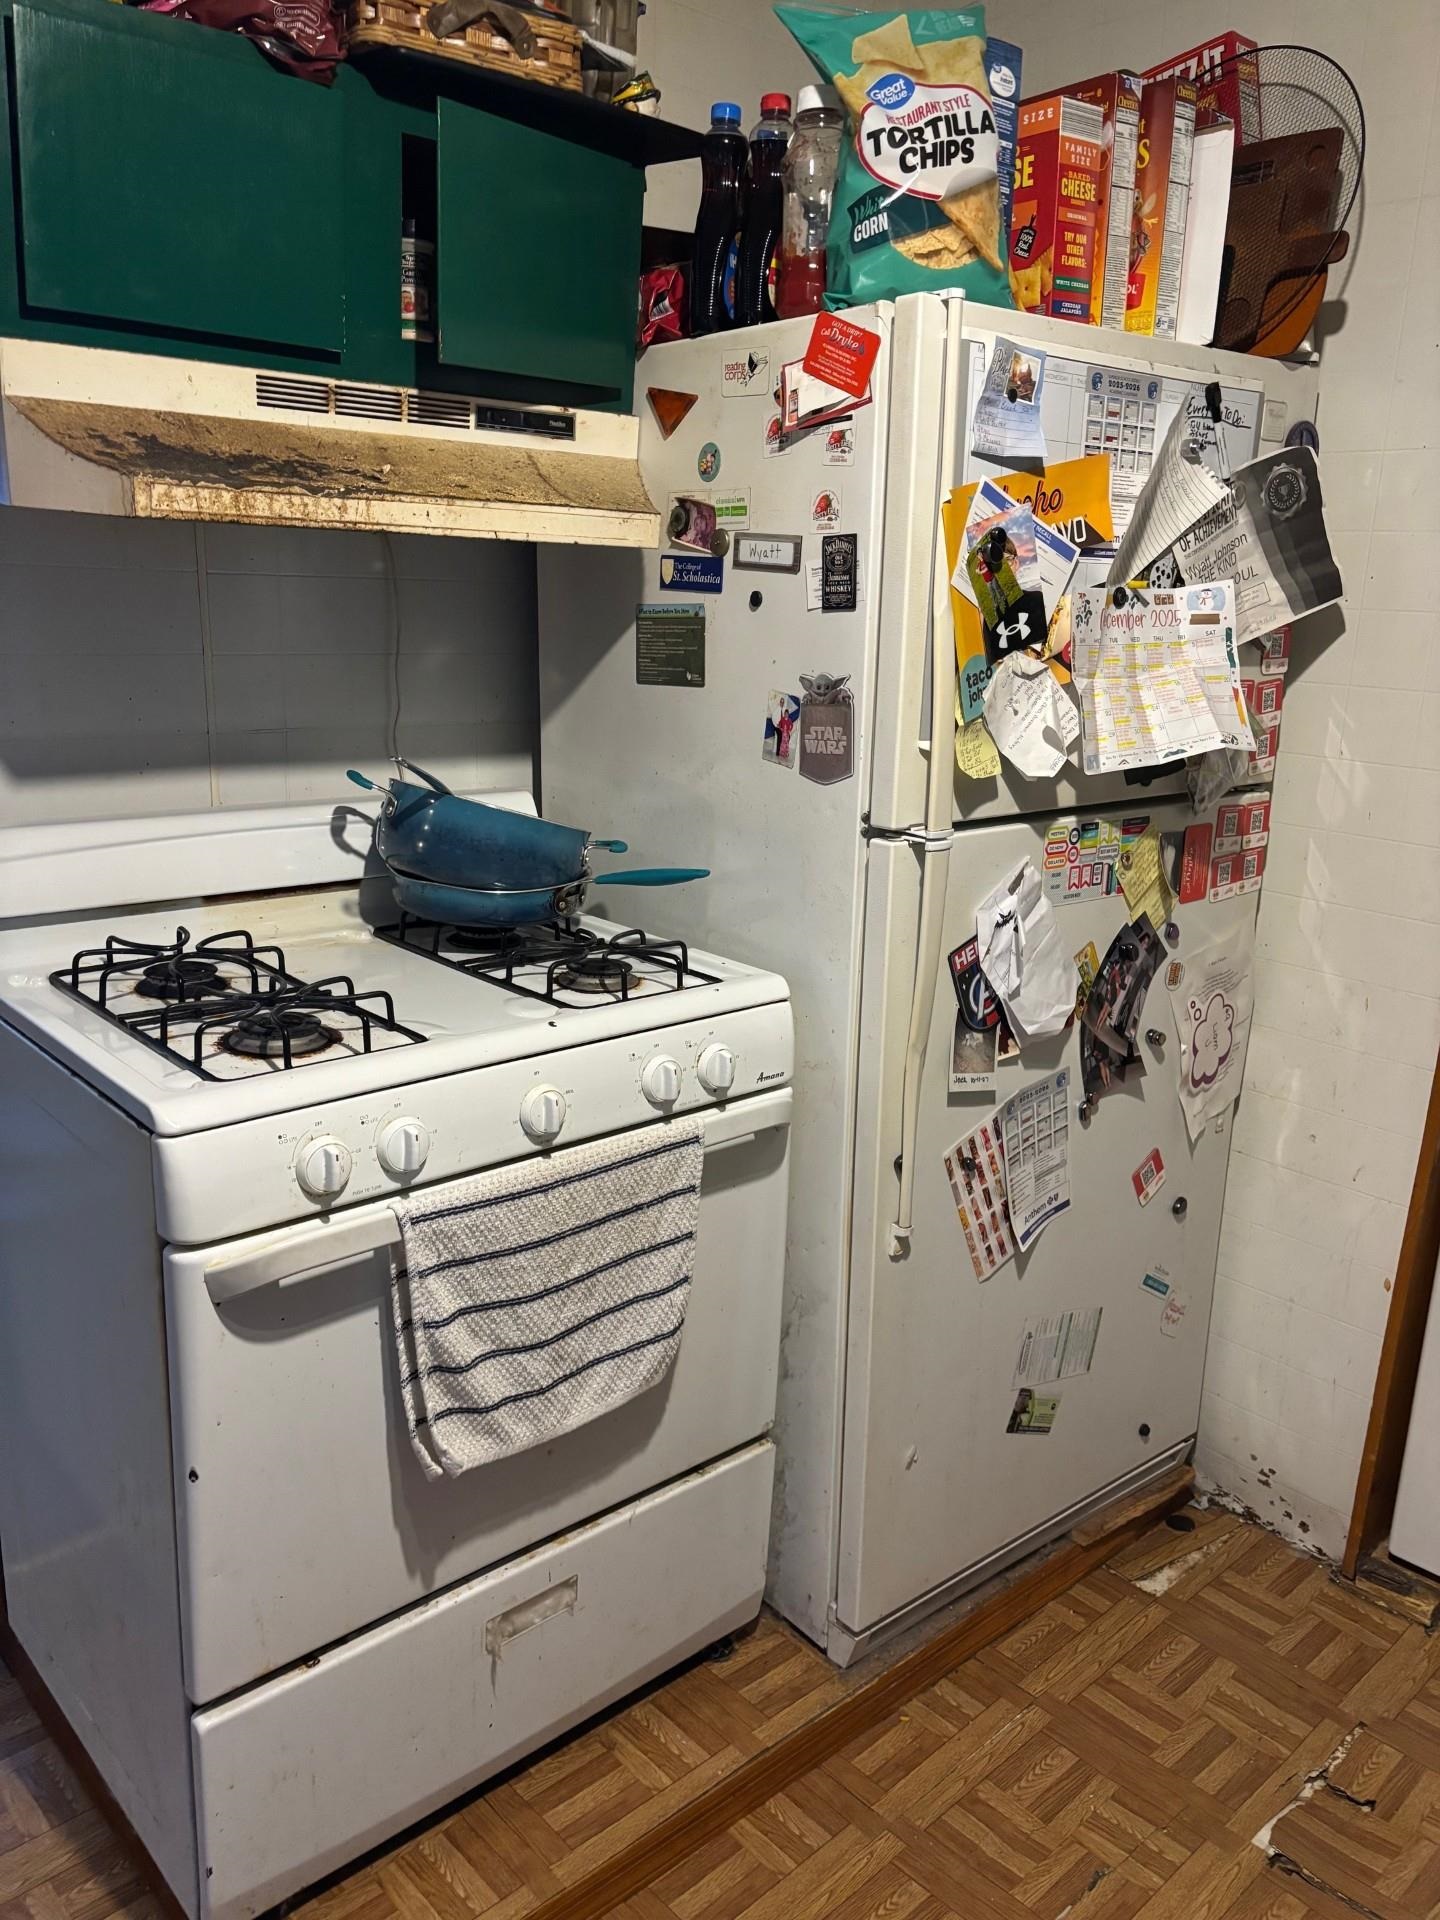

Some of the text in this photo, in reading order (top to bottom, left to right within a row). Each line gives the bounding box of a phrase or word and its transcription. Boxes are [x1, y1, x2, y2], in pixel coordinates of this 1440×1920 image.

[870, 78, 906, 101] Great
[880, 90, 908, 105] Value
[886, 94, 972, 127] RESTAURANT STYLE
[1023, 107, 1054, 125] SIZE
[866, 109, 996, 157] TORTILLA
[899, 137, 975, 174] CHIPS
[1065, 142, 1097, 158] FAMILY
[1071, 154, 1091, 166] SIZE
[1068, 171, 1091, 182] BAKED
[1061, 177, 1097, 202] CHEESE
[853, 211, 889, 243] CORN
[1018, 240, 1030, 251] Real
[1064, 231, 1087, 245] TRY OUR
[1066, 244, 1084, 256] OTHER
[1070, 281, 1090, 289] CHEDDAR
[1062, 301, 1082, 309] CHEDDAR
[831, 320, 842, 330] GOT
[725, 362, 747, 373] reading
[725, 370, 747, 383] corps
[1108, 380, 1141, 391] 2025-2026
[1178, 534, 1192, 553] OF
[1193, 504, 1239, 543] ACHIEVEMENT
[749, 543, 782, 561] Wyatt
[1185, 533, 1249, 581] Wyatt Johnson
[675, 562, 683, 570] The
[682, 562, 697, 572] College
[1200, 552, 1238, 585] THE KIND
[673, 571, 721, 584] St. Scholastica
[1232, 565, 1259, 585] OUL
[826, 585, 852, 593] WHISKEY
[1151, 609, 1182, 628] 2025
[966, 666, 993, 689] taco
[804, 726, 847, 741] STAR
[804, 739, 847, 755] WARS
[756, 1071, 785, 1084] Amana
[1024, 1202, 1047, 1226] Anthem
